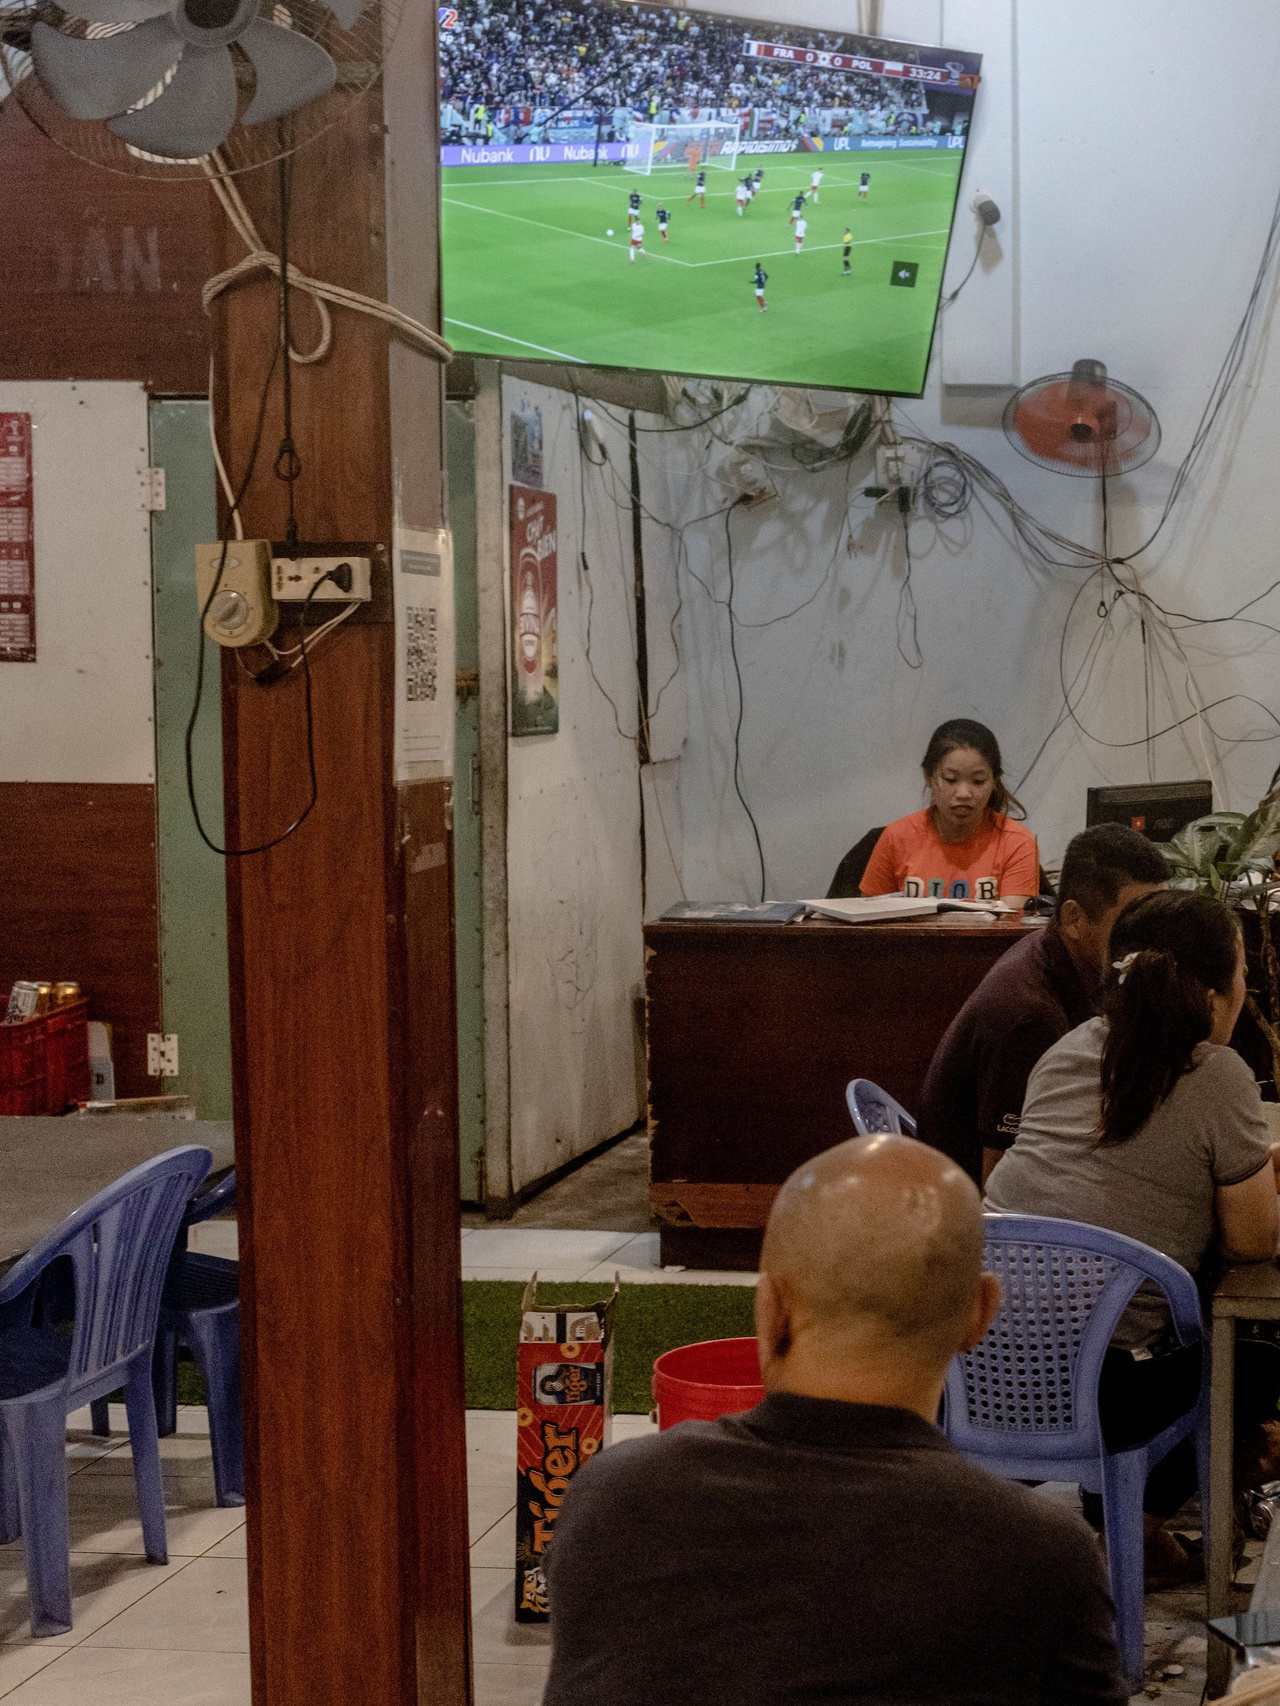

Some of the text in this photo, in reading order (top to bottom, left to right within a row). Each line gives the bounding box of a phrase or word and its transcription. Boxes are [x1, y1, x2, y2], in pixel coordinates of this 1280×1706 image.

[773, 47, 942, 81] FRA 0 0 POL 33:24
[834, 137, 851, 151] UPL
[461, 148, 514, 164] Nubank
[906, 881, 999, 900] DIOR
[565, 1366, 588, 1402] Tiger
